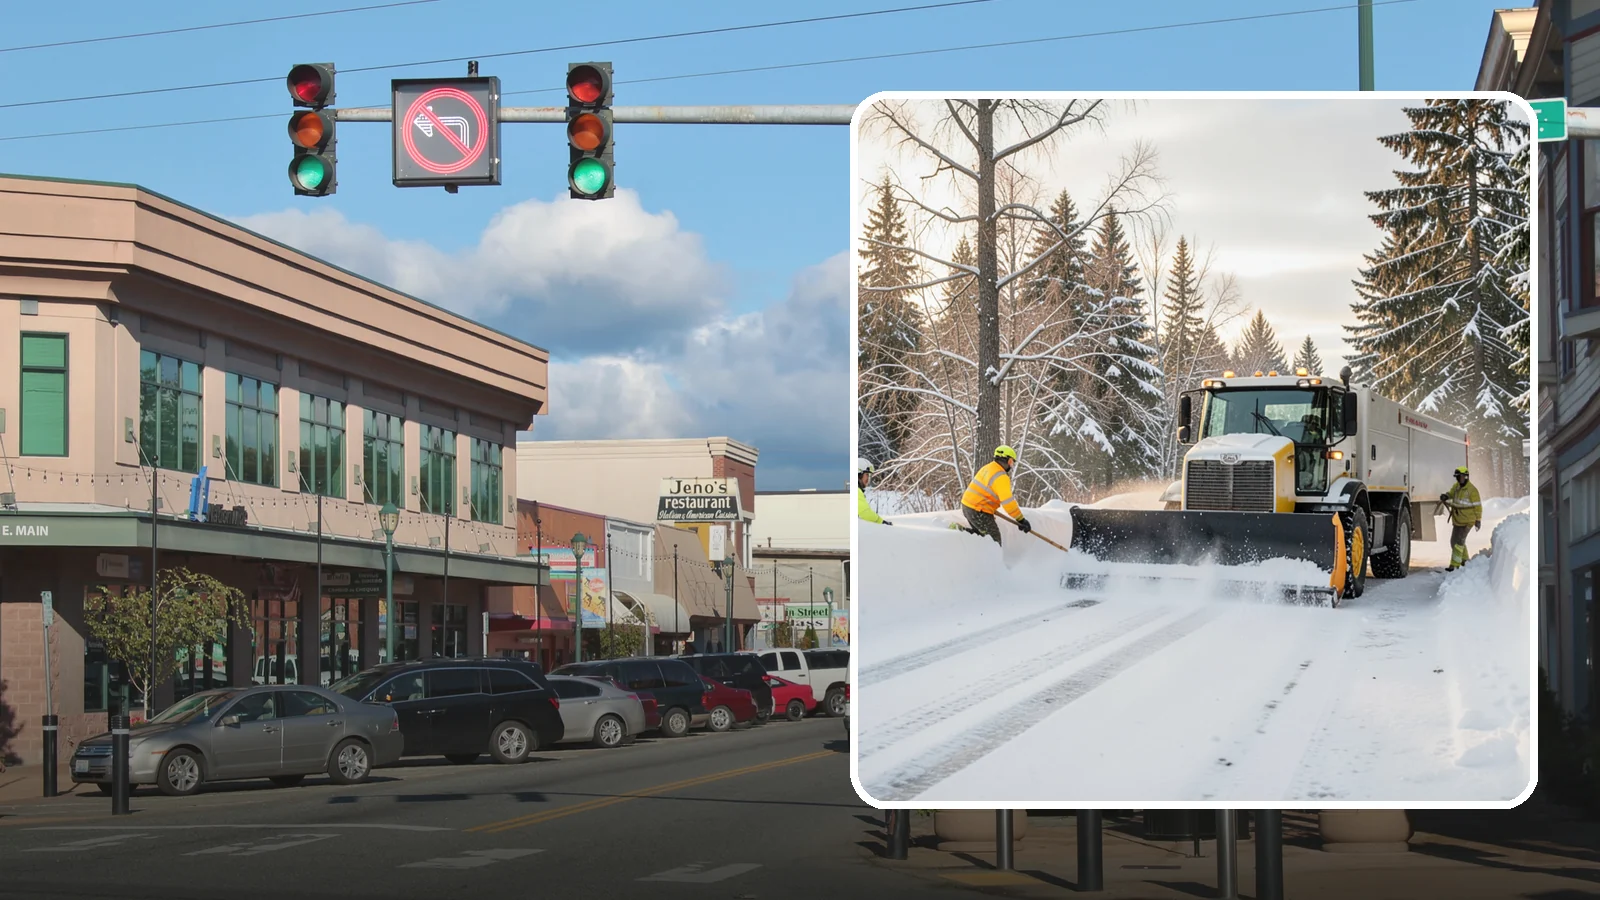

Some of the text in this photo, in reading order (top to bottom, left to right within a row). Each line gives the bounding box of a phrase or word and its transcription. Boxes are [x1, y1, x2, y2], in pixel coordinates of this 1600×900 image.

[670, 480, 727, 494] Jeno's
[665, 496, 731, 509] restaurant
[658, 509, 681, 520] Italian
[686, 509, 714, 519] American
[715, 509, 737, 519] Cuisine
[2, 525, 49, 536] E. MAIN
[797, 607, 828, 616] Street
